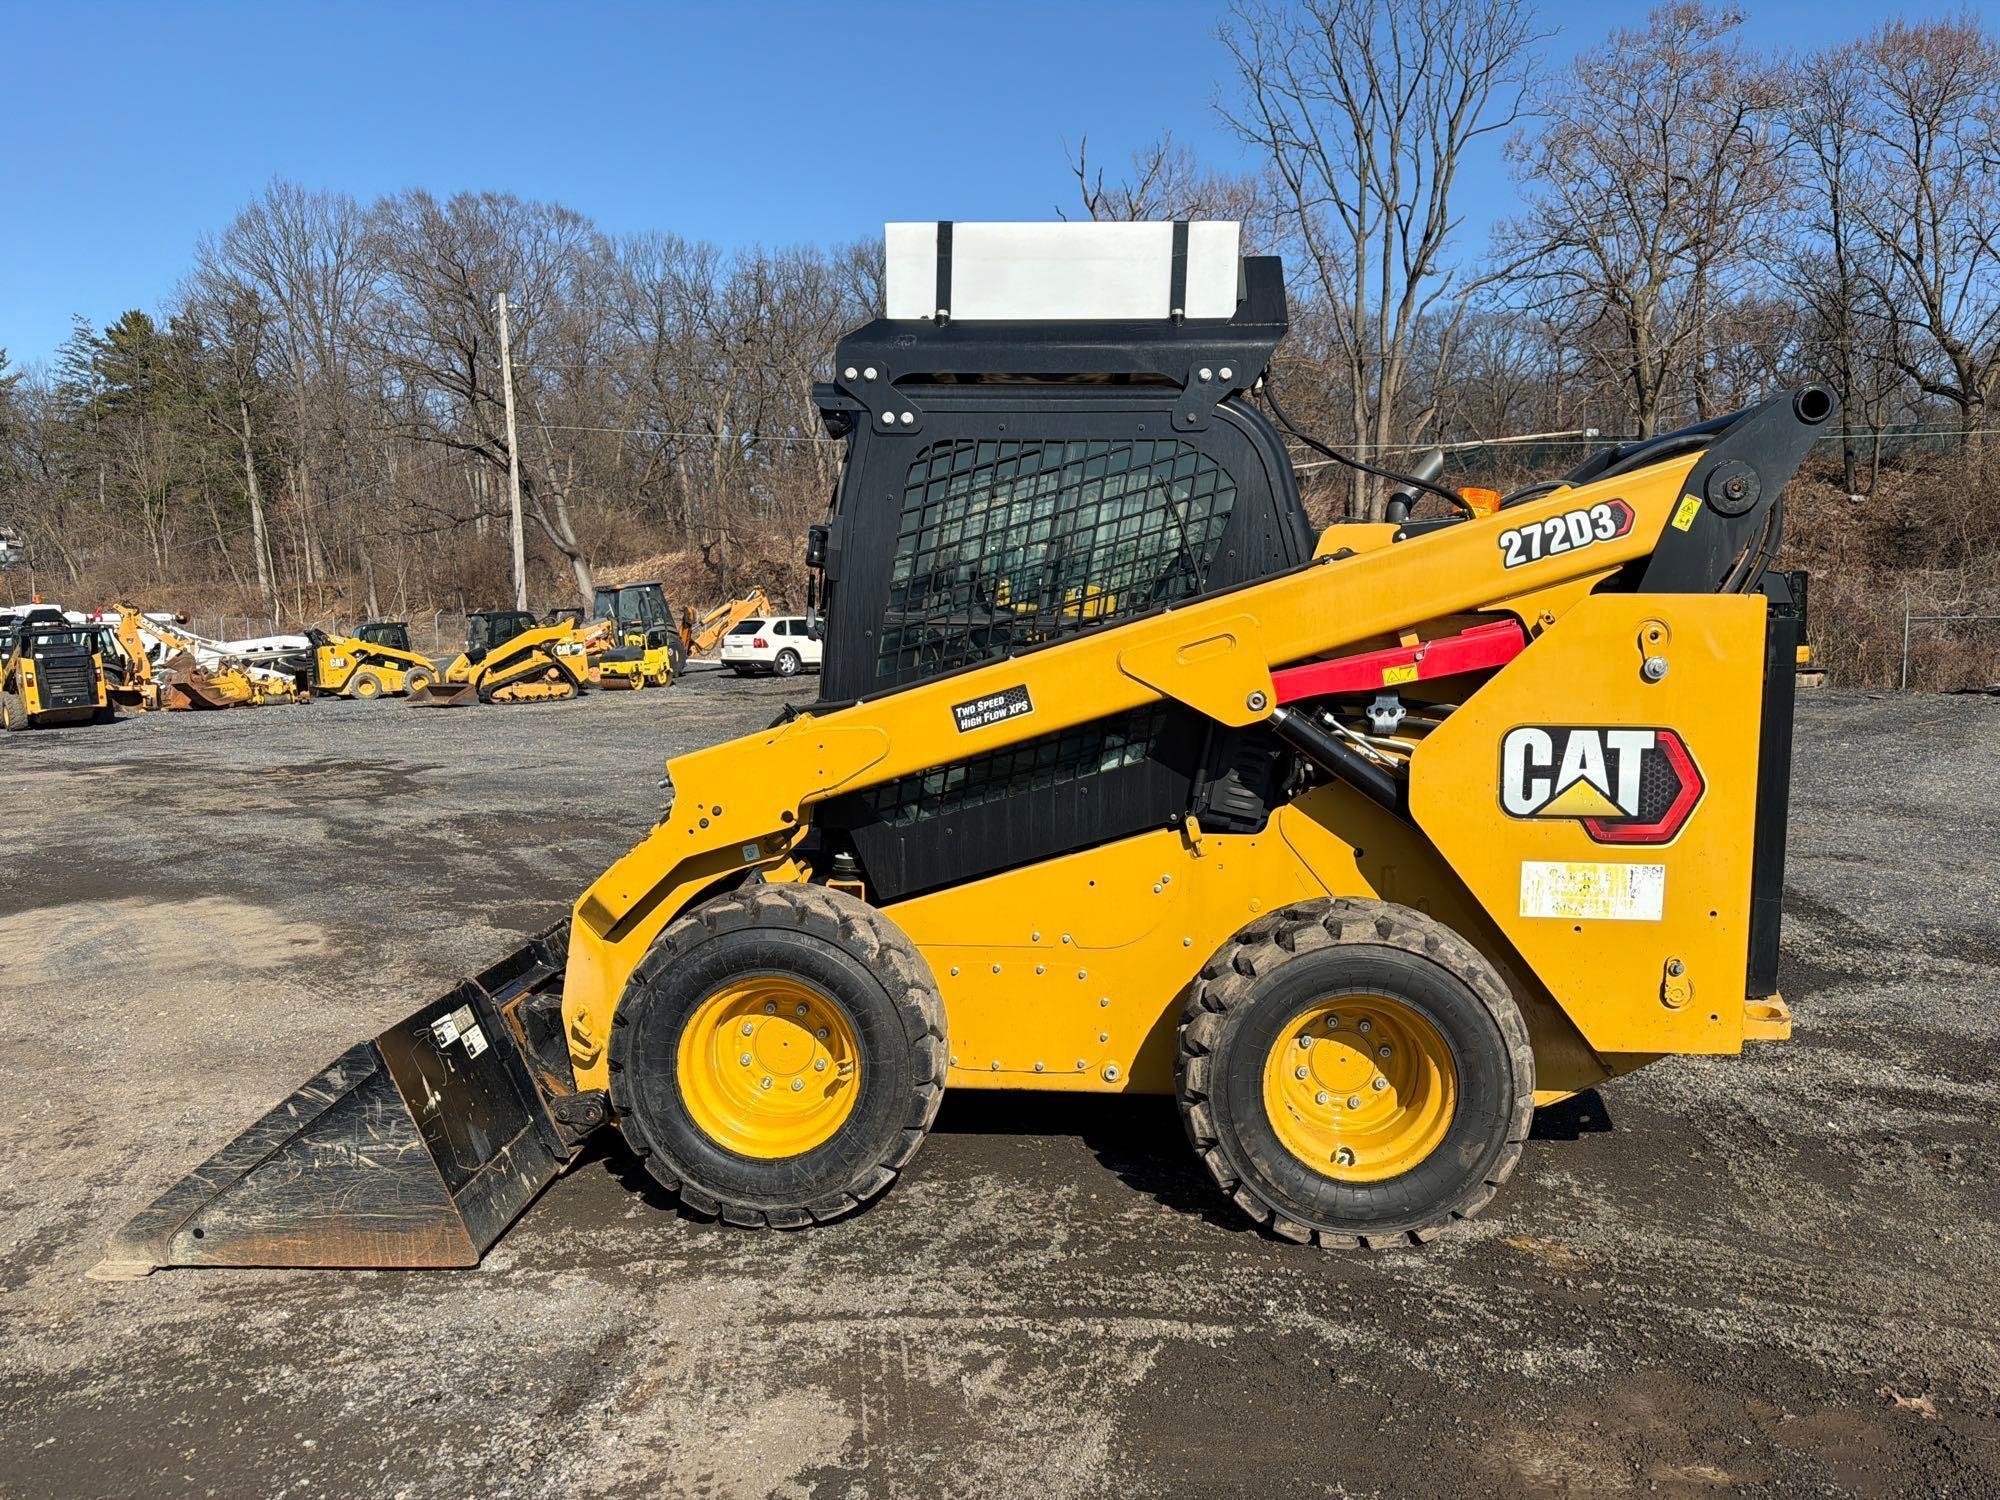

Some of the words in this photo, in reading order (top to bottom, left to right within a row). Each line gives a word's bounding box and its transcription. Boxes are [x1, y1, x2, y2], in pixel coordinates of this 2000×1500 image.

[1499, 504, 1616, 567] 272D3
[330, 657, 345, 667] CAT
[1009, 701, 1028, 715] XPS
[1504, 728, 1655, 817] CAT
